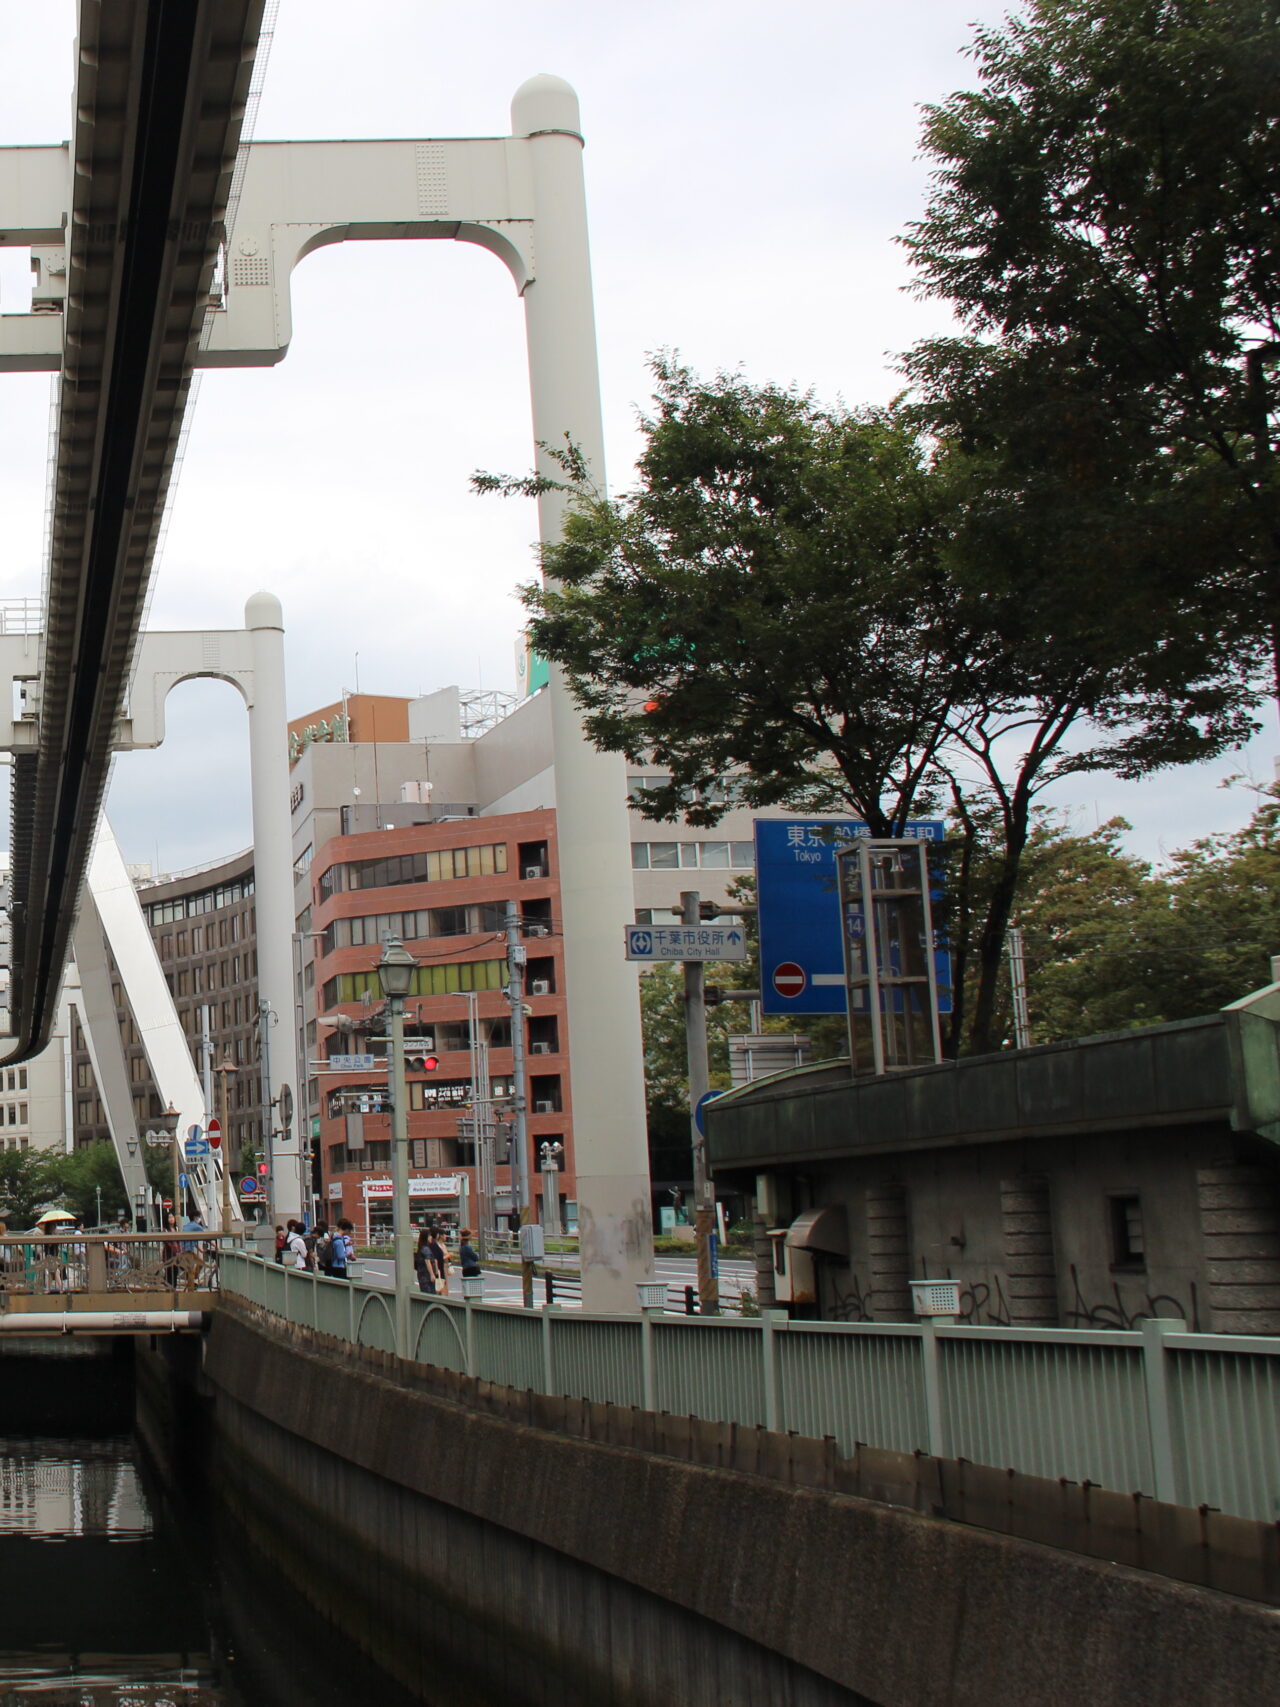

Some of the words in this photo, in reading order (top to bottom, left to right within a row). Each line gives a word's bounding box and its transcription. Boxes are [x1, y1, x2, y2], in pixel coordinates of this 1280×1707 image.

[786, 826, 826, 847] 東京
[794, 850, 822, 864] Tokyo
[846, 918, 862, 934] 14
[654, 930, 724, 946] 千葉市役所
[661, 947, 684, 956] Chiba
[687, 947, 702, 957] City
[705, 947, 720, 956] Hall
[332, 1055, 372, 1064] 中央公園
